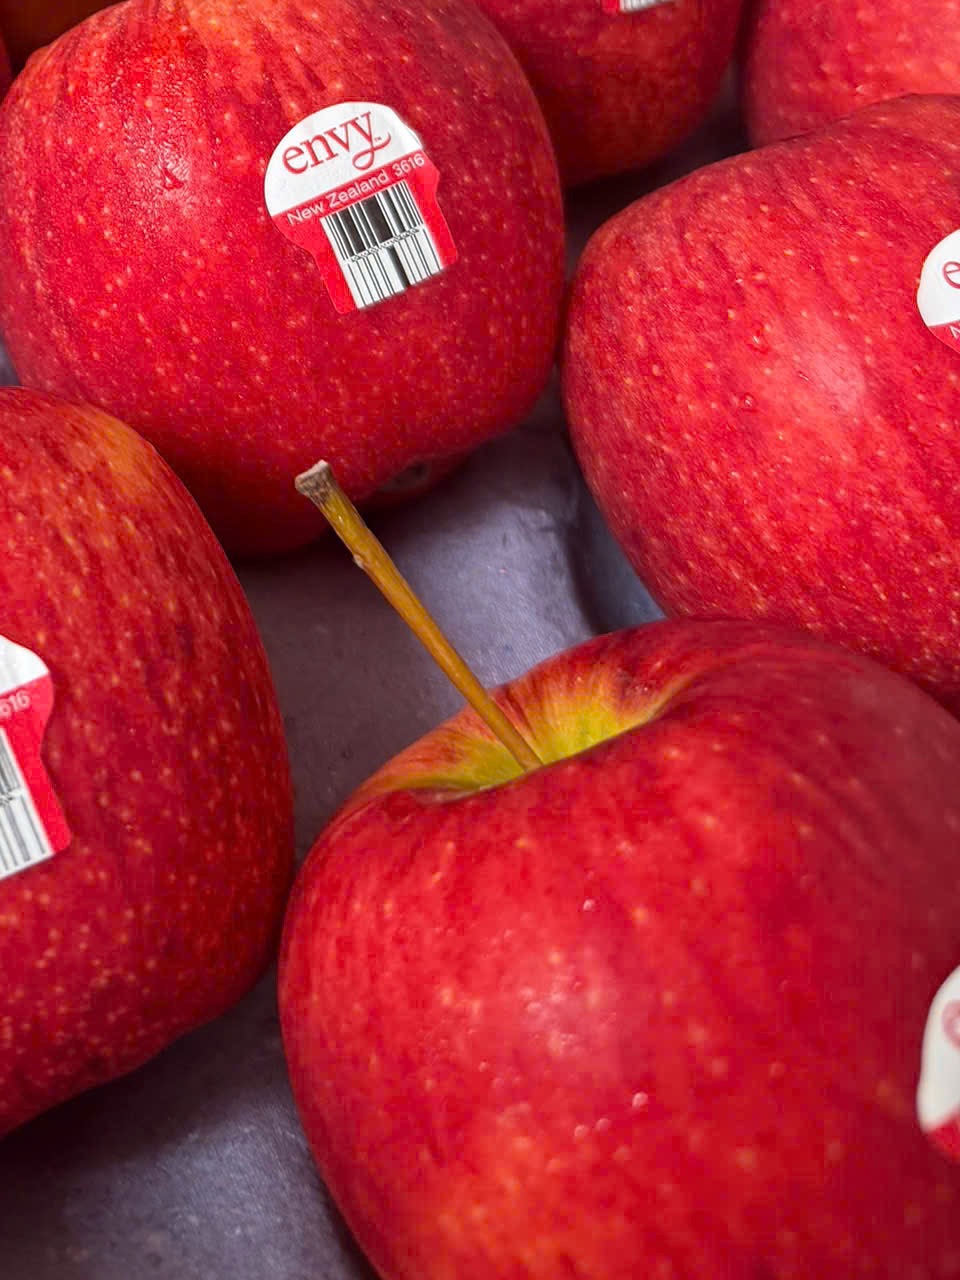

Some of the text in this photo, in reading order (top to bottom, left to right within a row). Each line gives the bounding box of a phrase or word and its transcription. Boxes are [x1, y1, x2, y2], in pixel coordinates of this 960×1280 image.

[282, 111, 392, 175] envy
[287, 154, 426, 226] New Zealand 3616
